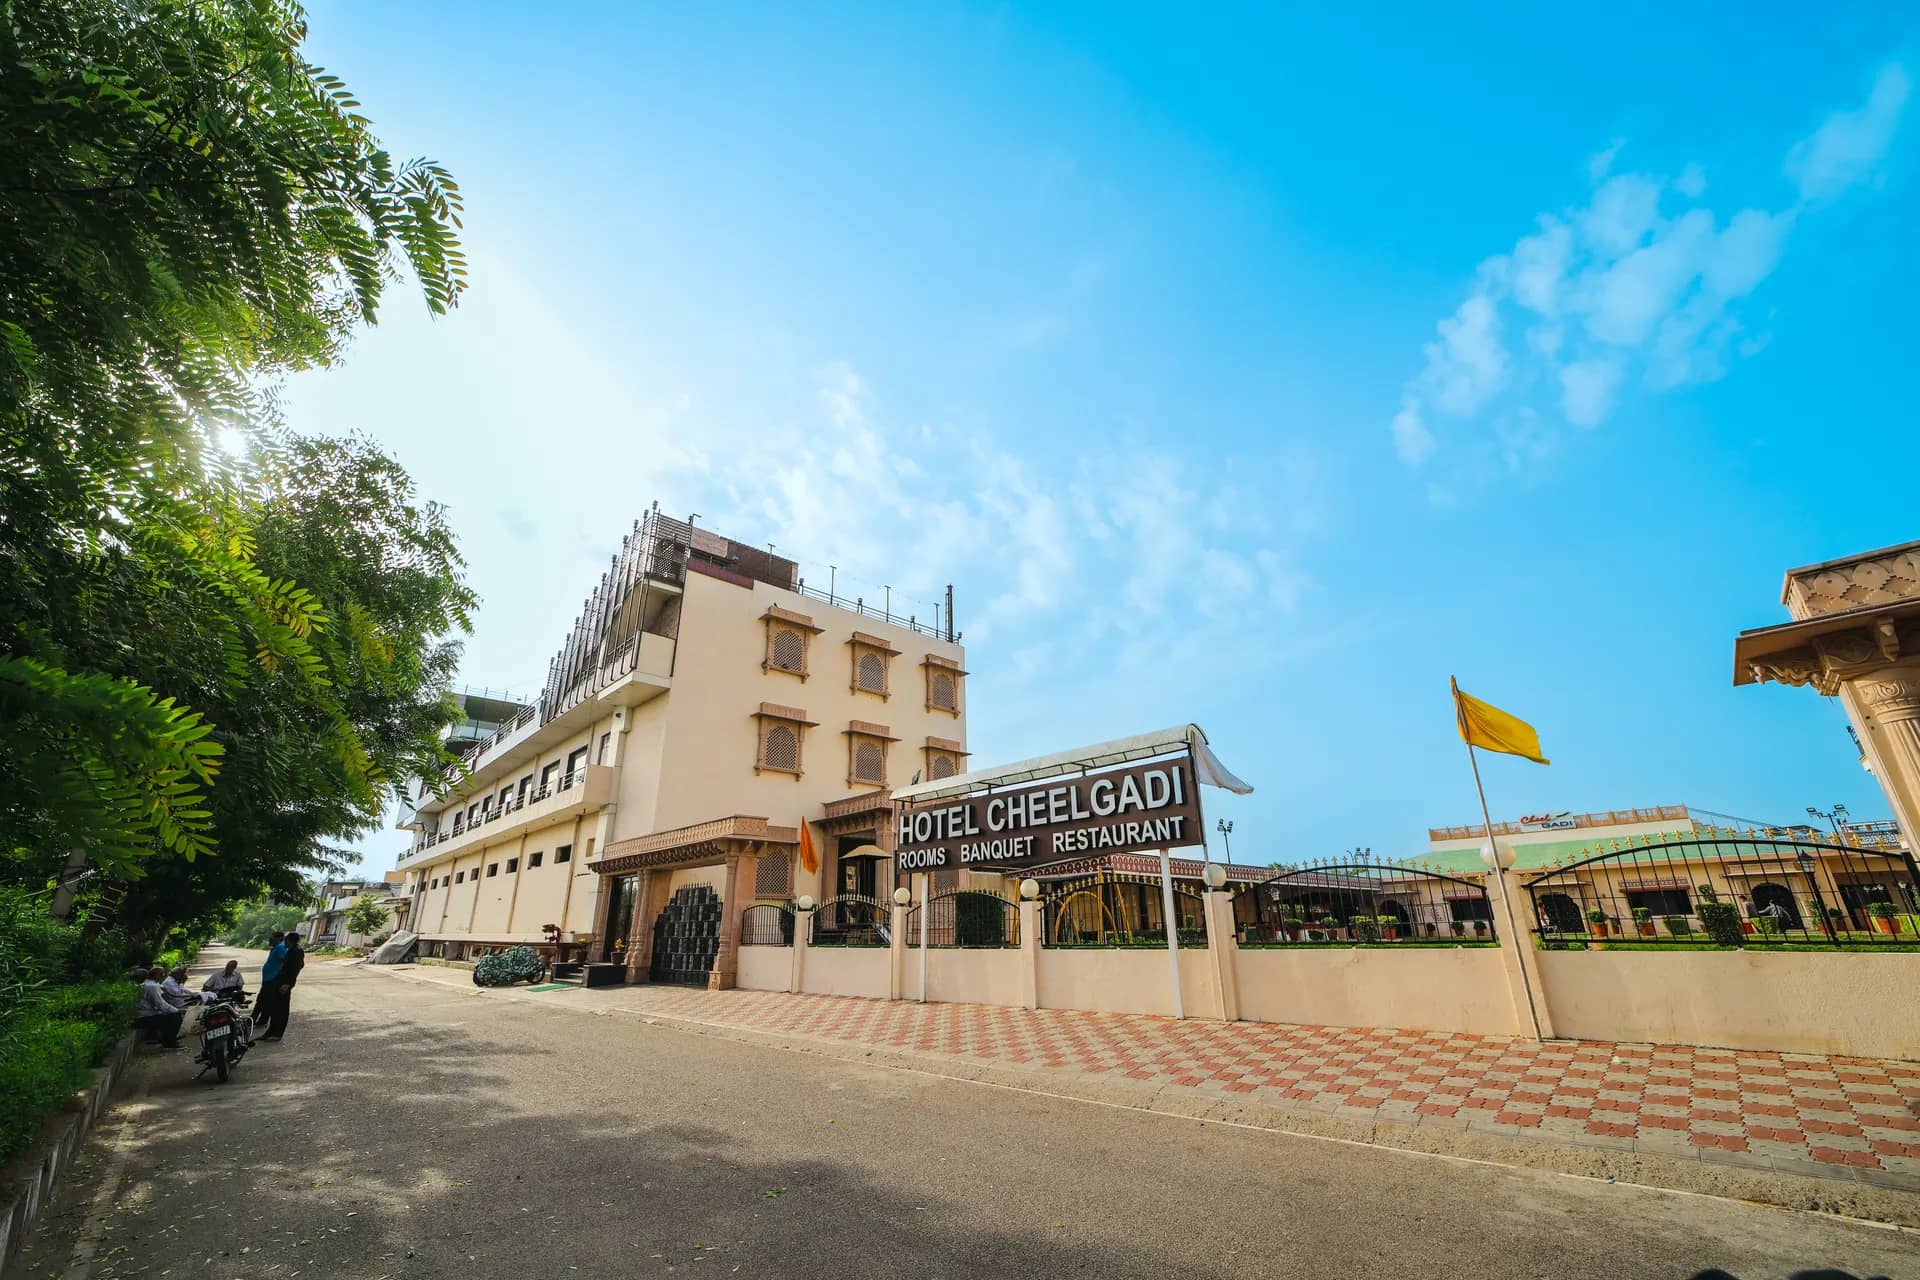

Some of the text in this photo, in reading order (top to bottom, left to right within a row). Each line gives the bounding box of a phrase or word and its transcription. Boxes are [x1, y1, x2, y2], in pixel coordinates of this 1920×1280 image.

[899, 765, 1184, 844] HOTEL CHEELGADI
[1541, 820, 1573, 829] GADI
[899, 815, 1184, 869] ROOMS BANQUET RESTAURANT
